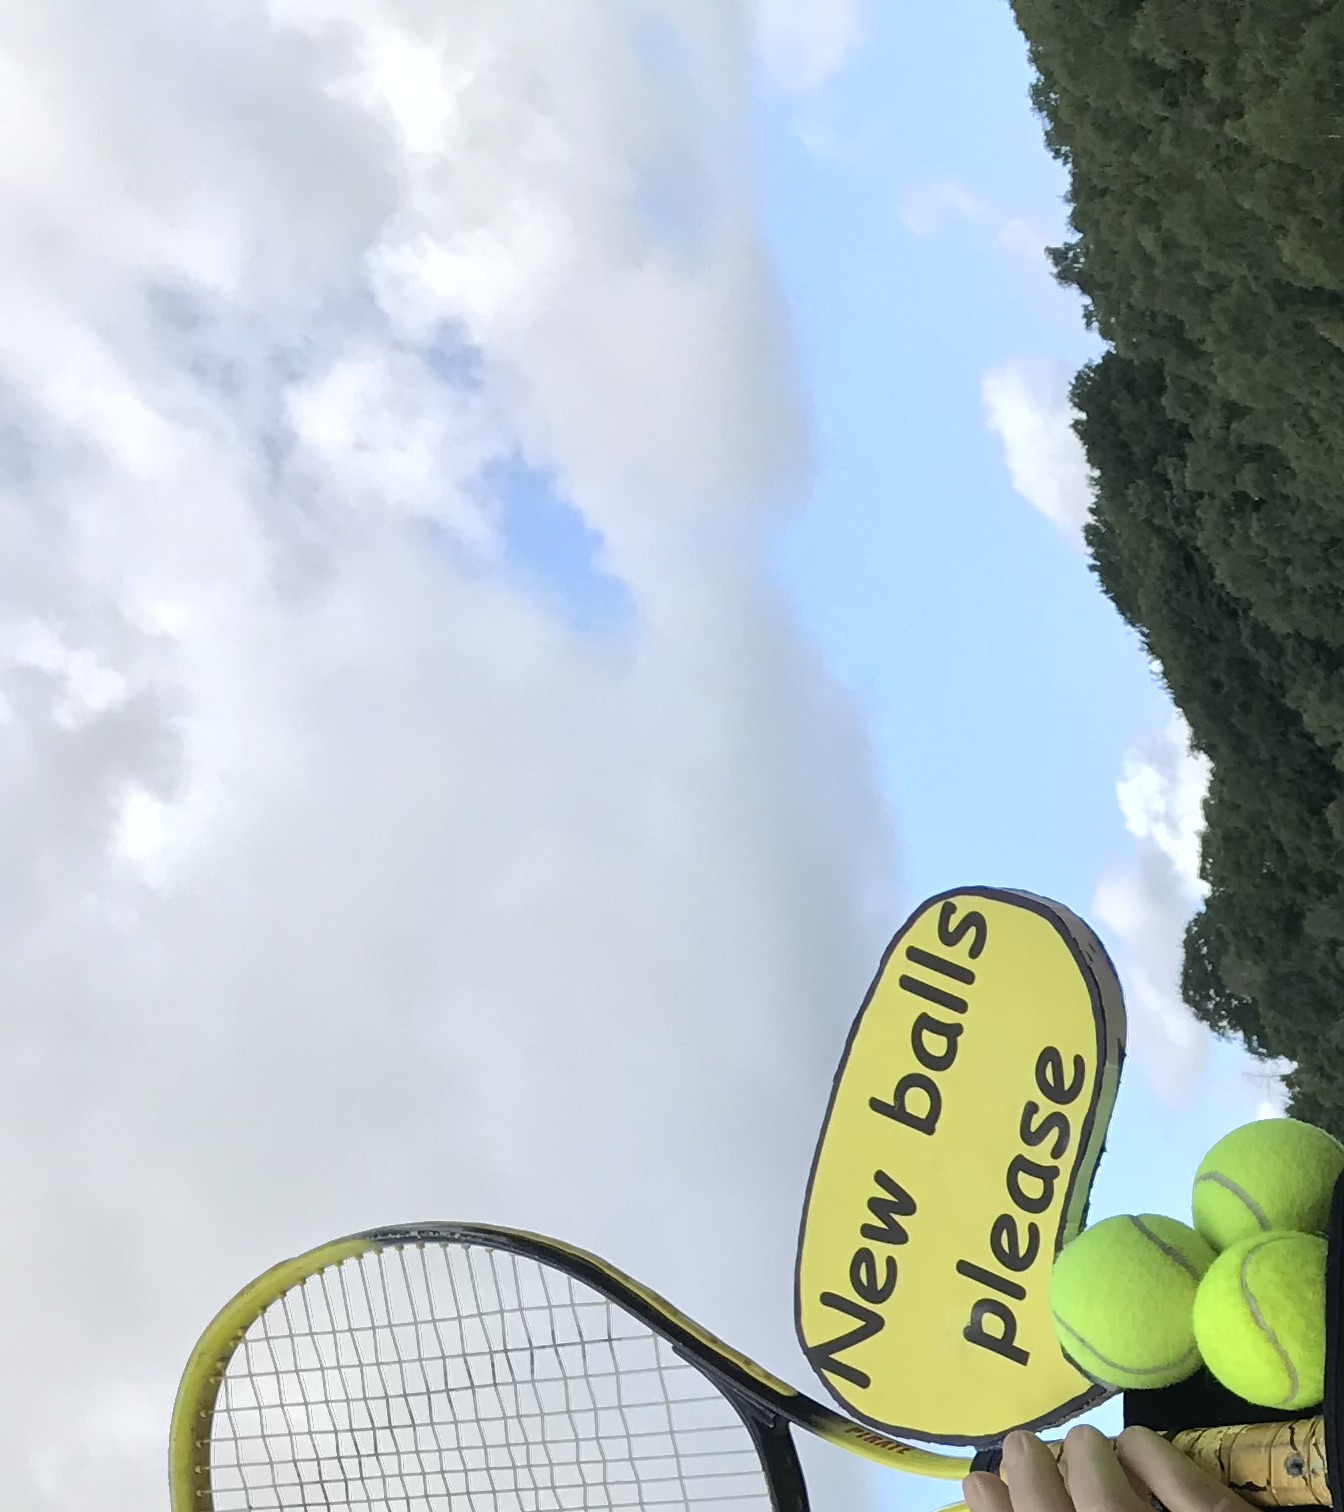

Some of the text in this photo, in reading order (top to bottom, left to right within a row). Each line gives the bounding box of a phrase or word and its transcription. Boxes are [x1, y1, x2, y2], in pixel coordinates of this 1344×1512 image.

[809, 900, 988, 1389] New balls
[956, 1045, 1085, 1367] please
